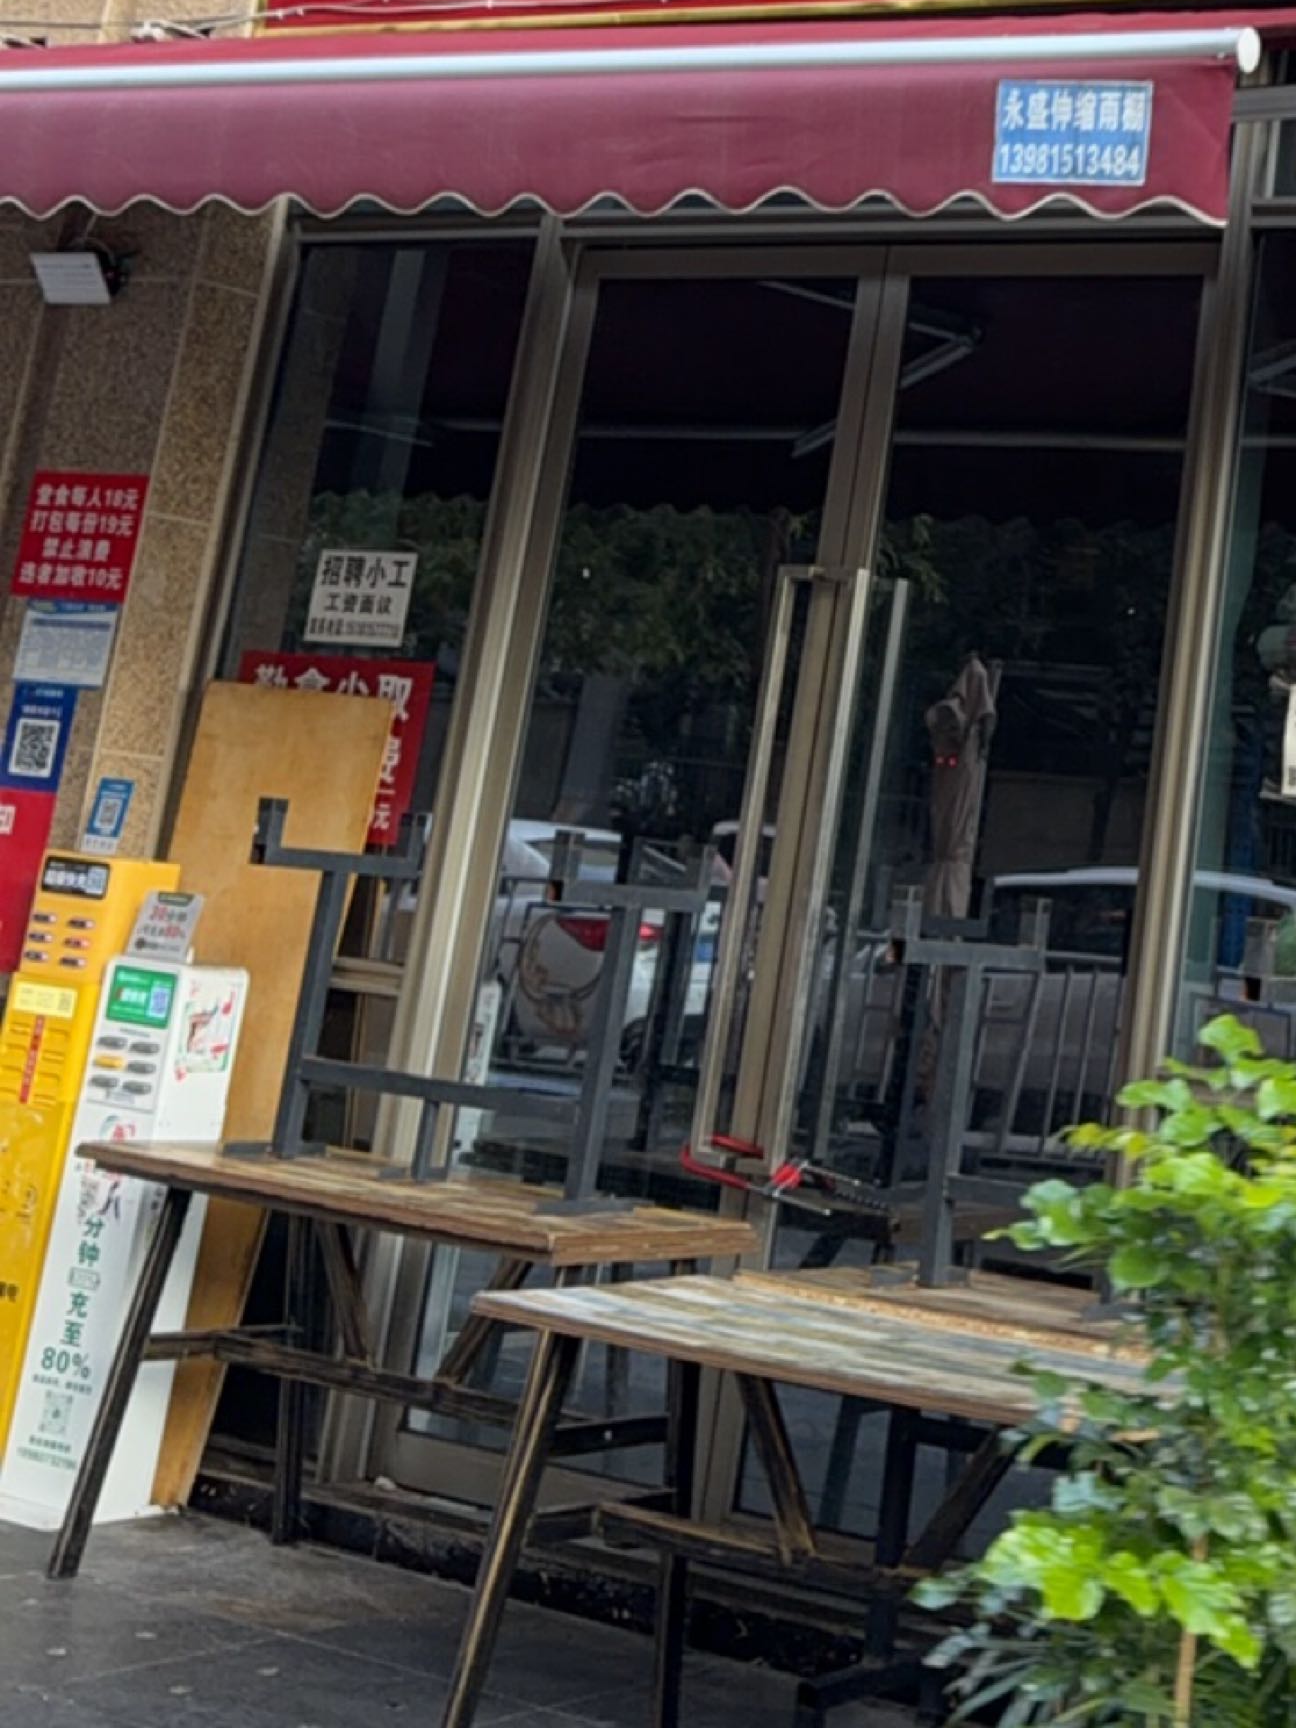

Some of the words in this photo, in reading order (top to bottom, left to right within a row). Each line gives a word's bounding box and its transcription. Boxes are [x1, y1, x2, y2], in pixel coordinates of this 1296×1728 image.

[322, 556, 410, 588] 招聘小工
[41, 1346, 91, 1380] 80%
